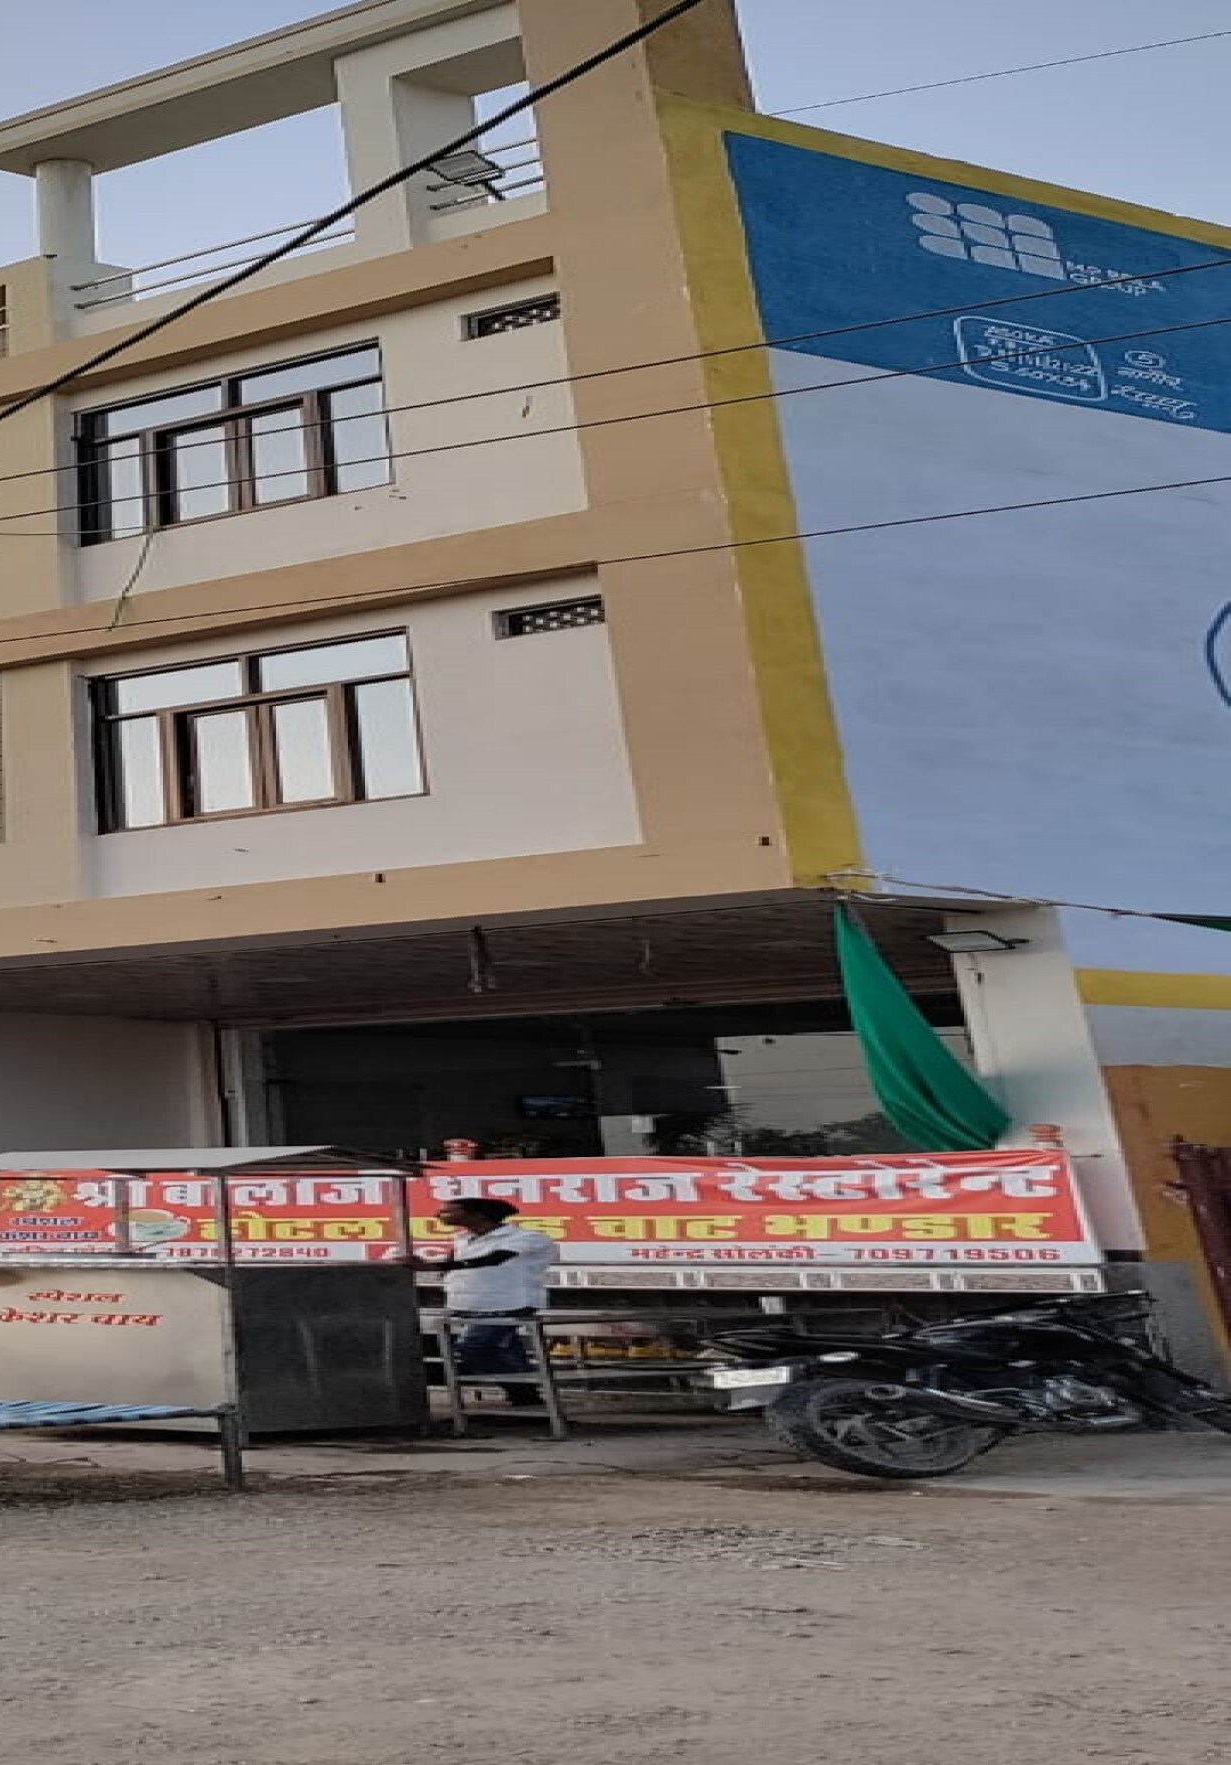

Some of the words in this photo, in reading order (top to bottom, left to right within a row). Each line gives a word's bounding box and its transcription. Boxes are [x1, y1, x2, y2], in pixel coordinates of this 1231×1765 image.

[160, 1176, 419, 1207] बलाज
[429, 1172, 704, 1204] धनराज
[196, 1210, 390, 1241] होटल
[585, 1215, 743, 1240] चाट
[763, 1211, 1055, 1240] भण्डार
[91, 1312, 163, 1327] चाय
